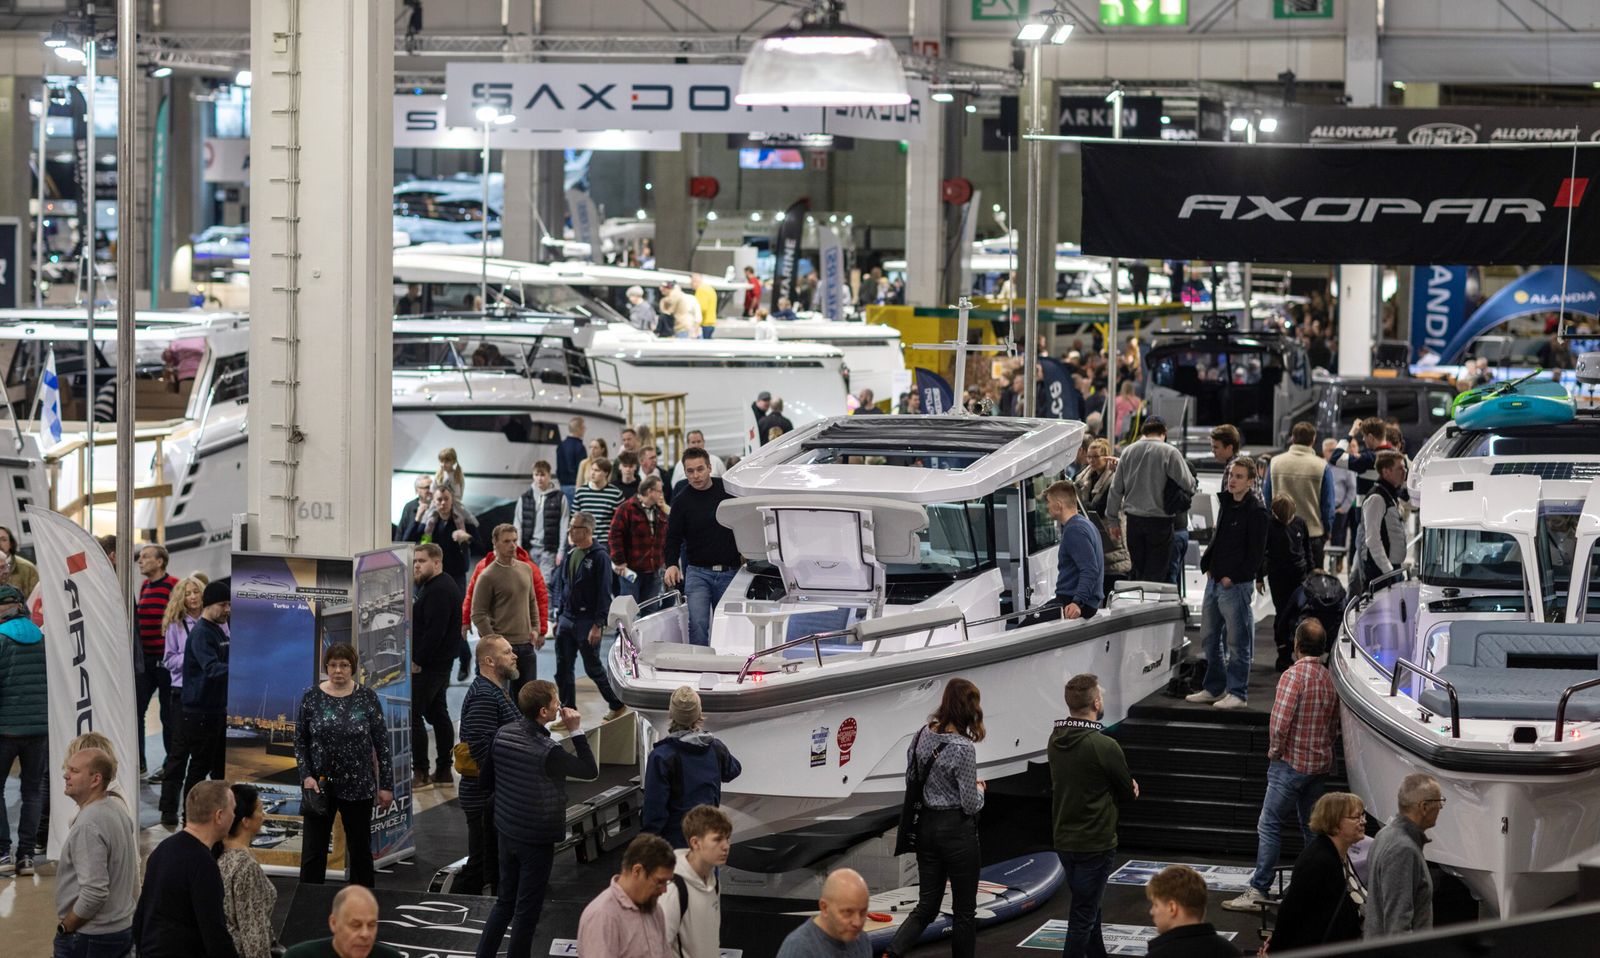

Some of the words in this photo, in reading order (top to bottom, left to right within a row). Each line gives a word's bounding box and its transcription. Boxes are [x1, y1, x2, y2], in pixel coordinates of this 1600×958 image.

[472, 83, 789, 112] SAXDO
[1310, 126, 1398, 139] ALLOYCRAFT
[1490, 128, 1579, 140] ALLOYCRAFT
[1177, 194, 1547, 224] AXOPAR
[1529, 290, 1597, 305] ALANDIA
[1424, 265, 1454, 352] ANDI
[297, 501, 335, 520] 601
